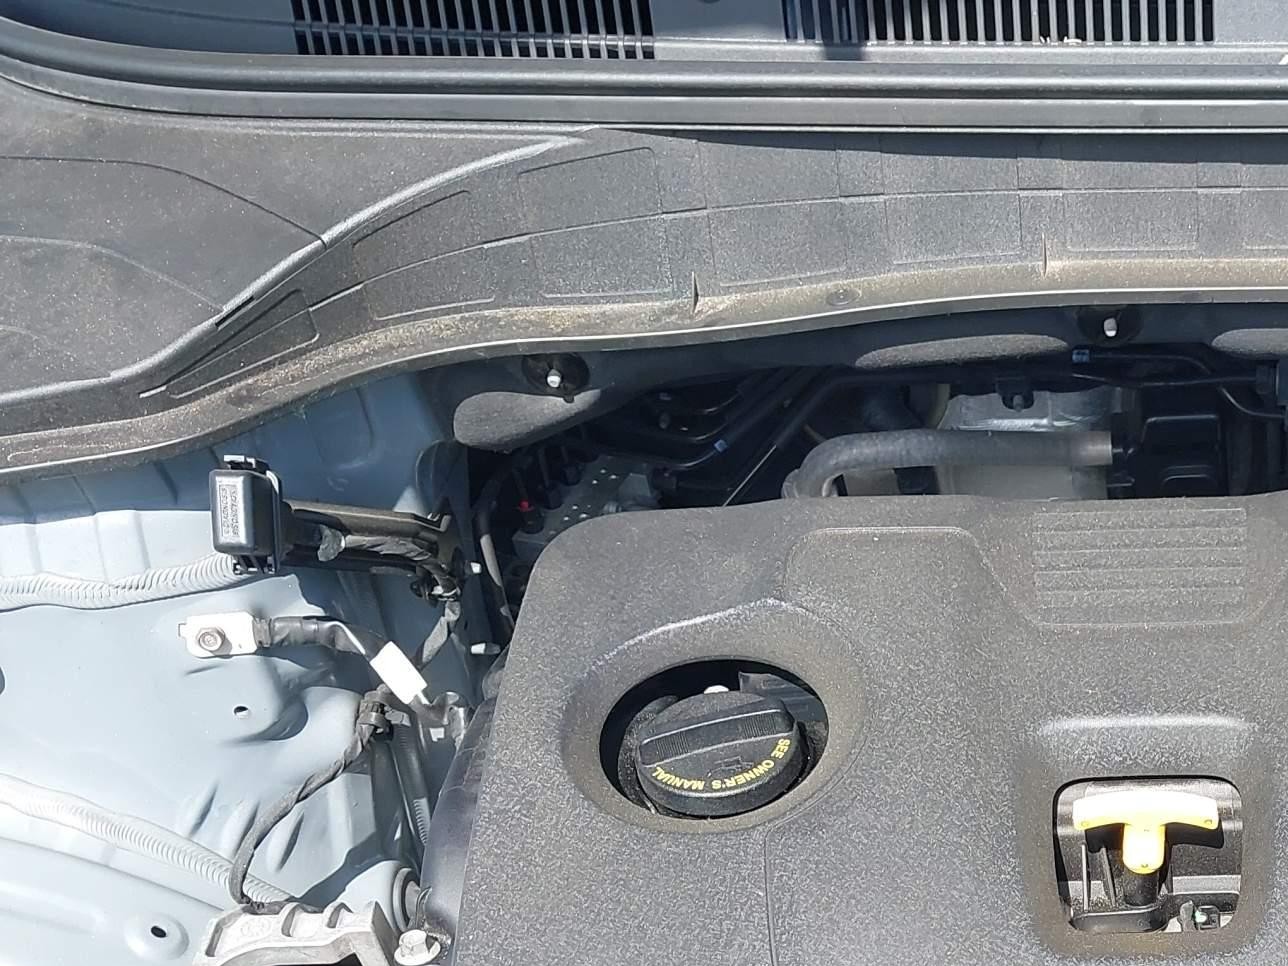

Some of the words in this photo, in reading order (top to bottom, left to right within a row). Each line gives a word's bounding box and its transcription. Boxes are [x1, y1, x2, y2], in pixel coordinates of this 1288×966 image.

[771, 738, 790, 759] SEE
[650, 766, 705, 790] MANUAL
[711, 758, 774, 789] OWNER'S
